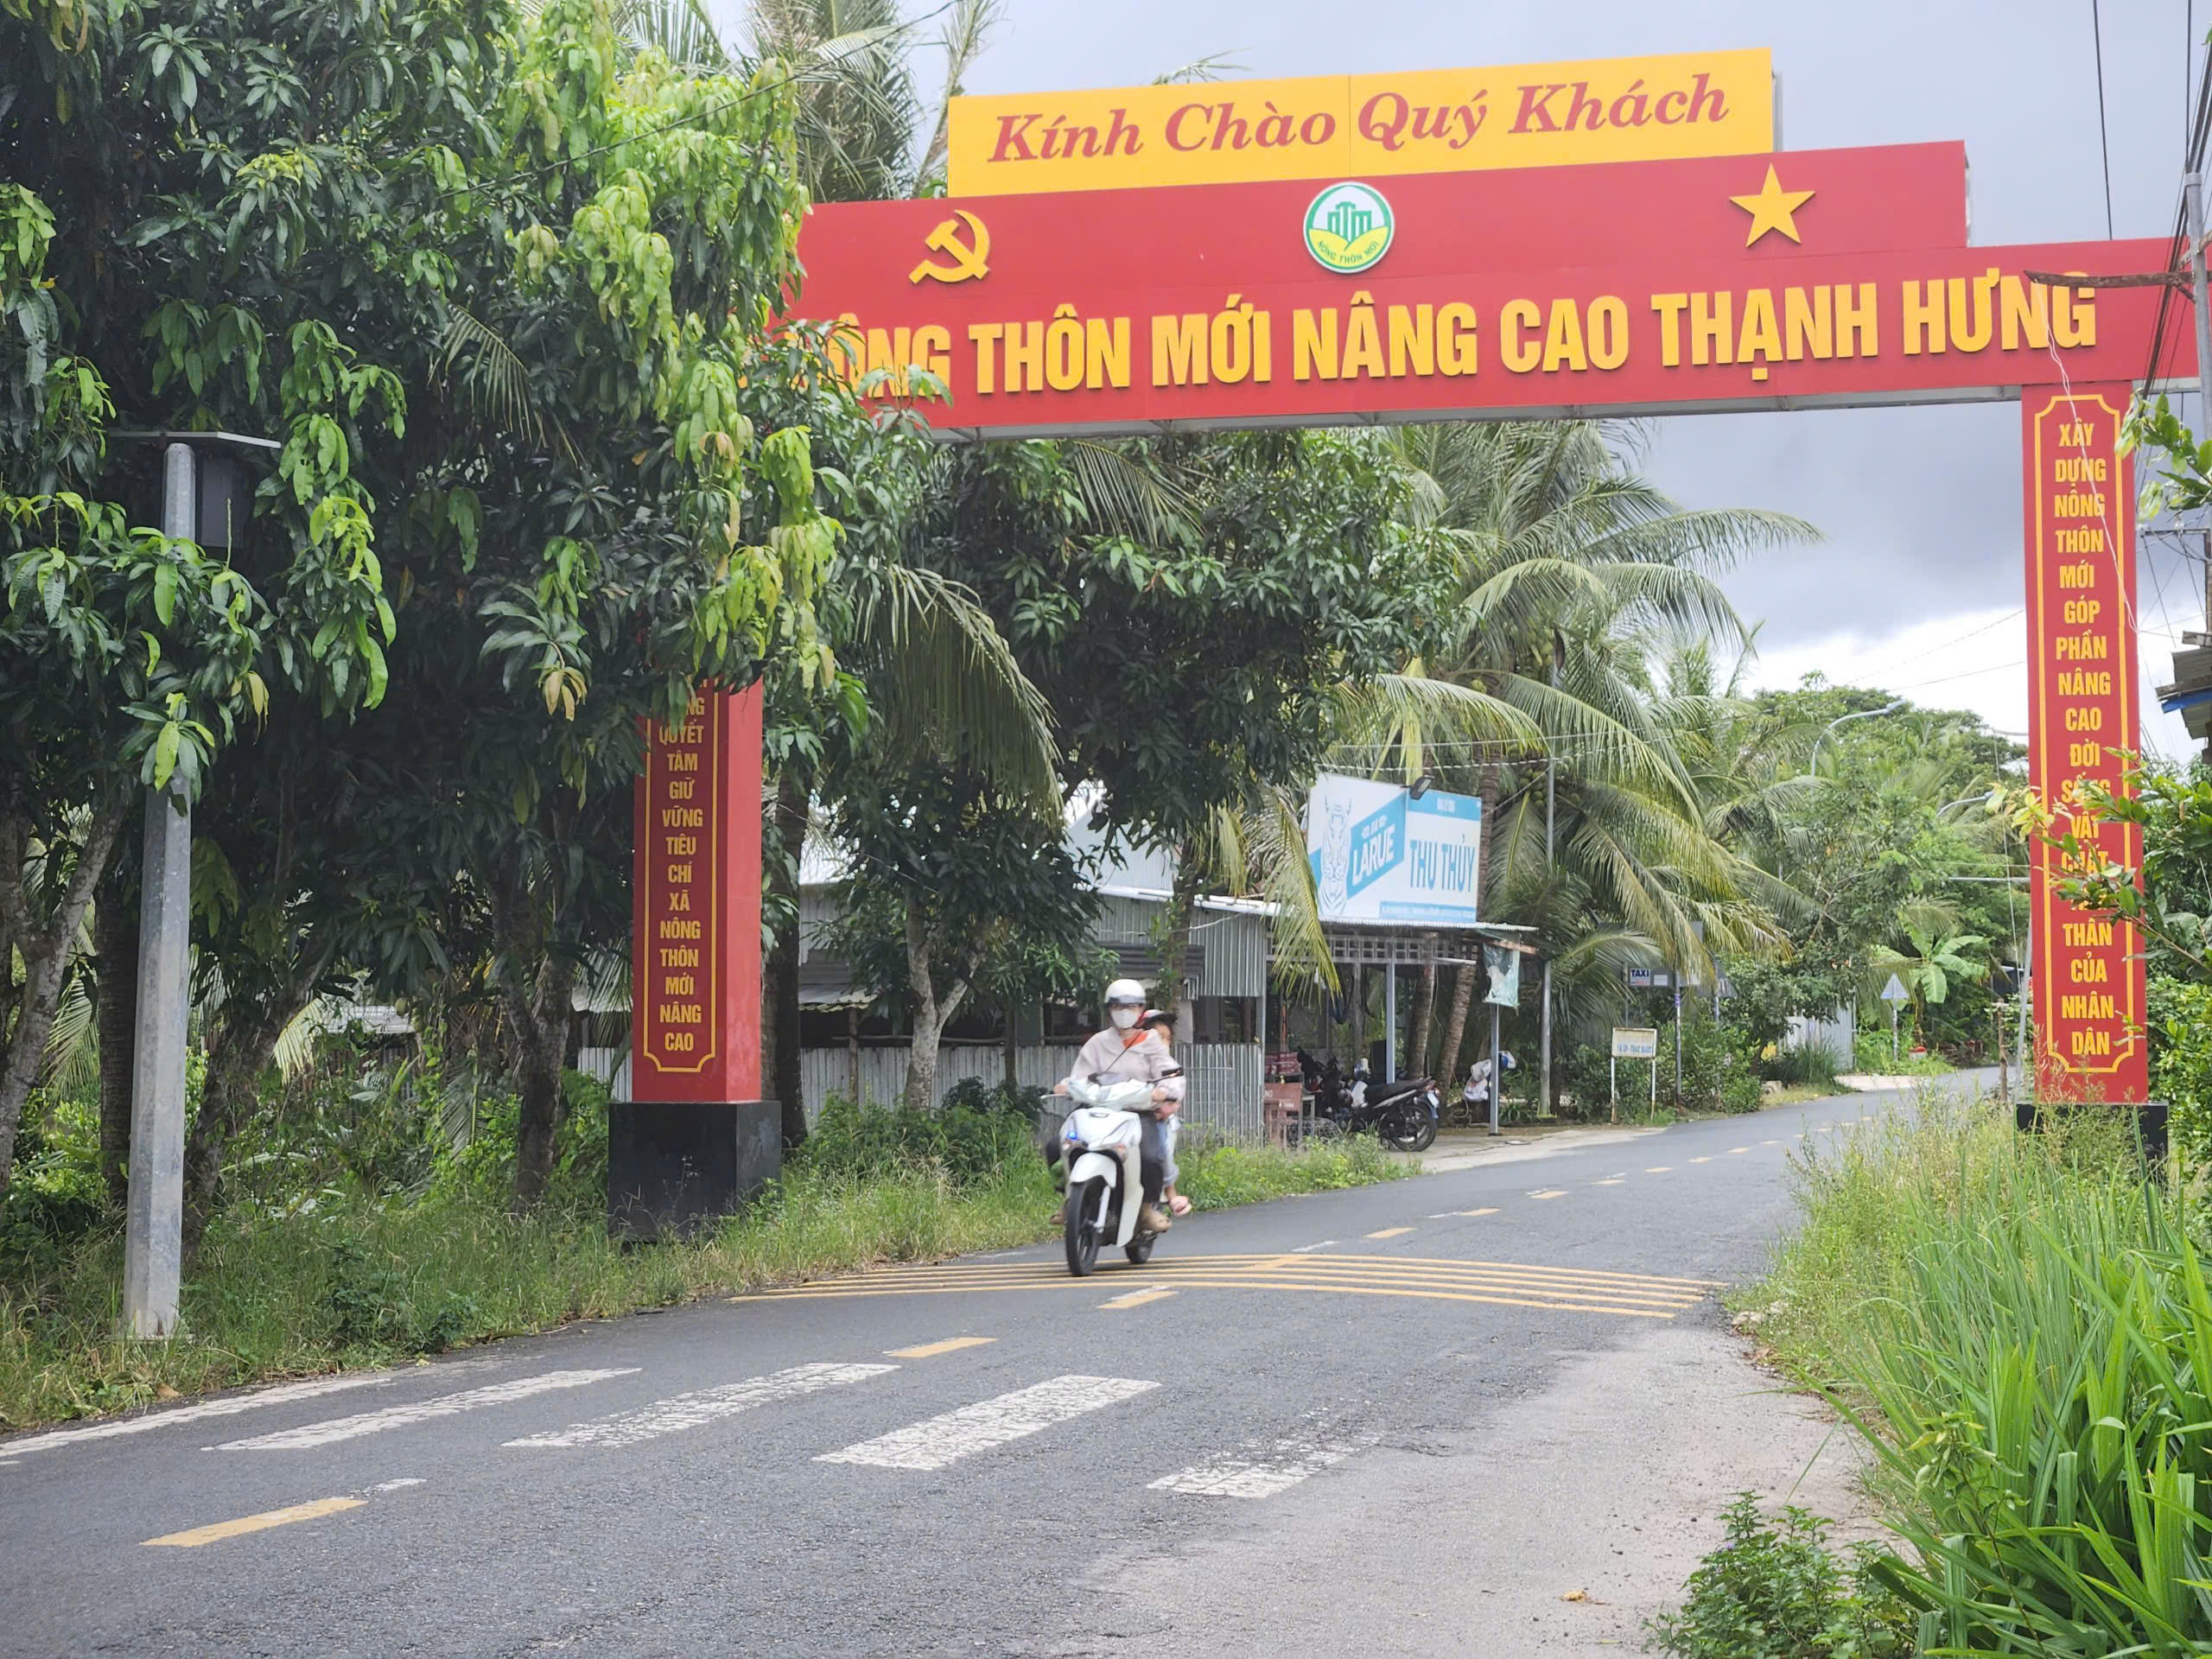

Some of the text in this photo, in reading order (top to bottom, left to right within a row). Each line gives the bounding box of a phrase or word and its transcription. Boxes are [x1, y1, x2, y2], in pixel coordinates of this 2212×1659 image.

[988, 73, 1729, 162] Kính Chào Quý Khách
[968, 303, 1131, 393] THÔN
[1151, 293, 1272, 386] MỚI
[1293, 289, 1478, 380] NÂNG
[1500, 295, 1630, 372] CAO
[1650, 283, 1879, 380] THẠNH
[1902, 267, 2097, 354] HƯNG
[2059, 418, 2094, 447] XÂY
[2055, 456, 2107, 487] DỰNG
[2054, 489, 2106, 518] NÔNG
[2055, 524, 2104, 554] THÔN
[2059, 561, 2094, 588] MỚI
[2063, 595, 2101, 624] GÓP
[2056, 629, 2107, 660] PHẦN
[2058, 666, 2111, 696] NÂNG
[658, 718, 704, 746] QUYẾT
[2065, 707, 2102, 732] CAO
[667, 749, 698, 772] TÂM
[2069, 739, 2101, 767] ĐỜI
[669, 777, 696, 800] GIỮ
[662, 804, 703, 828] VỮNG
[665, 833, 697, 856] TIÊU
[1351, 823, 1396, 887] LARUE
[667, 861, 692, 884] CHÍ
[1409, 839, 1438, 890] THU
[669, 889, 690, 912] XÃ
[659, 917, 702, 940] NÔNG
[2063, 918, 2113, 947] THÂN
[659, 944, 699, 968] THÔN
[2070, 950, 2107, 983] CỦA
[664, 972, 695, 996] MỚI
[1630, 969, 1649, 977] TAXI
[659, 1001, 702, 1024] NÂNG
[2062, 990, 2114, 1020] NHÂN
[664, 1032, 695, 1052] CAO
[2071, 1027, 2110, 1056] DÂN
